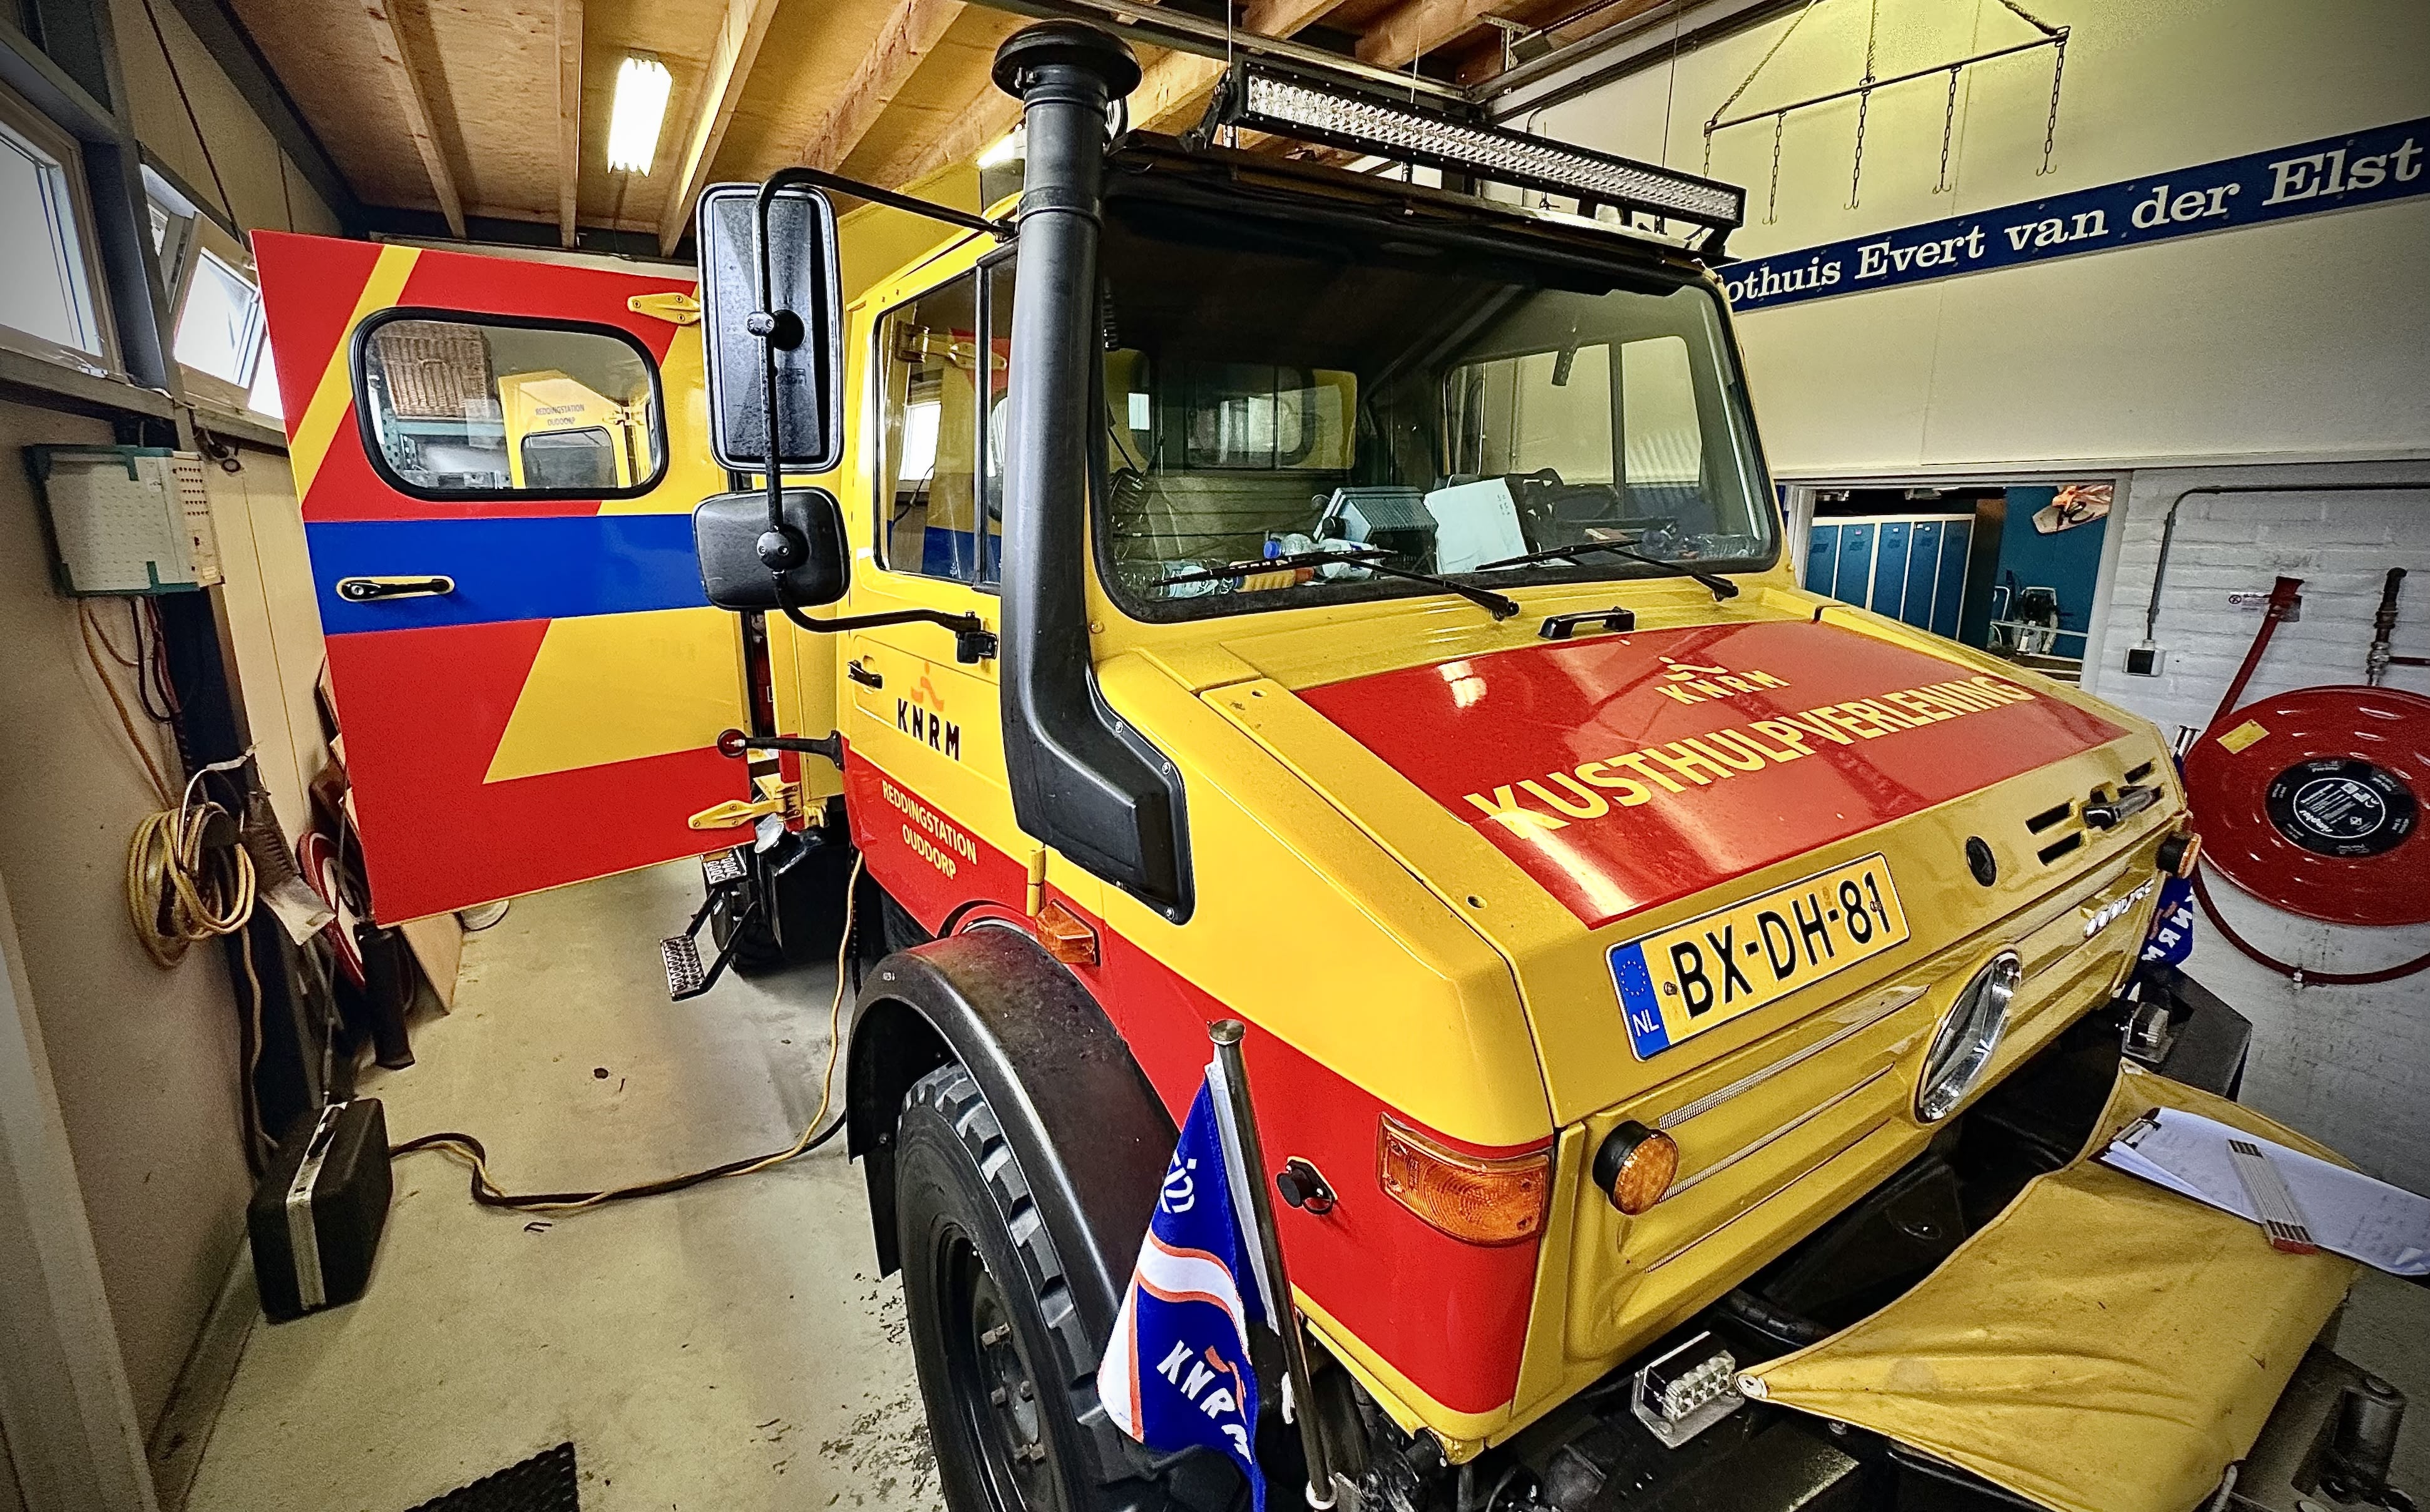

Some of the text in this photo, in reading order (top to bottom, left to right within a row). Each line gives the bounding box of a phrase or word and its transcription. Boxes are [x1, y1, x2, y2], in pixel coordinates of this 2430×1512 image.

[1855, 226, 1985, 280] Evert
[2004, 209, 2109, 251] van
[2131, 183, 2239, 228] der
[2262, 138, 2422, 206] Elst
[1654, 671, 1790, 705] KNRM
[898, 698, 960, 761] KNRM
[1464, 677, 2037, 840] KUSTHULPVERLENING
[882, 780, 977, 866] REDDINGSTATION
[902, 824, 956, 880] OUDDORP
[1669, 871, 1890, 1019] BX-DH-81
[1631, 1008, 1660, 1037] NL
